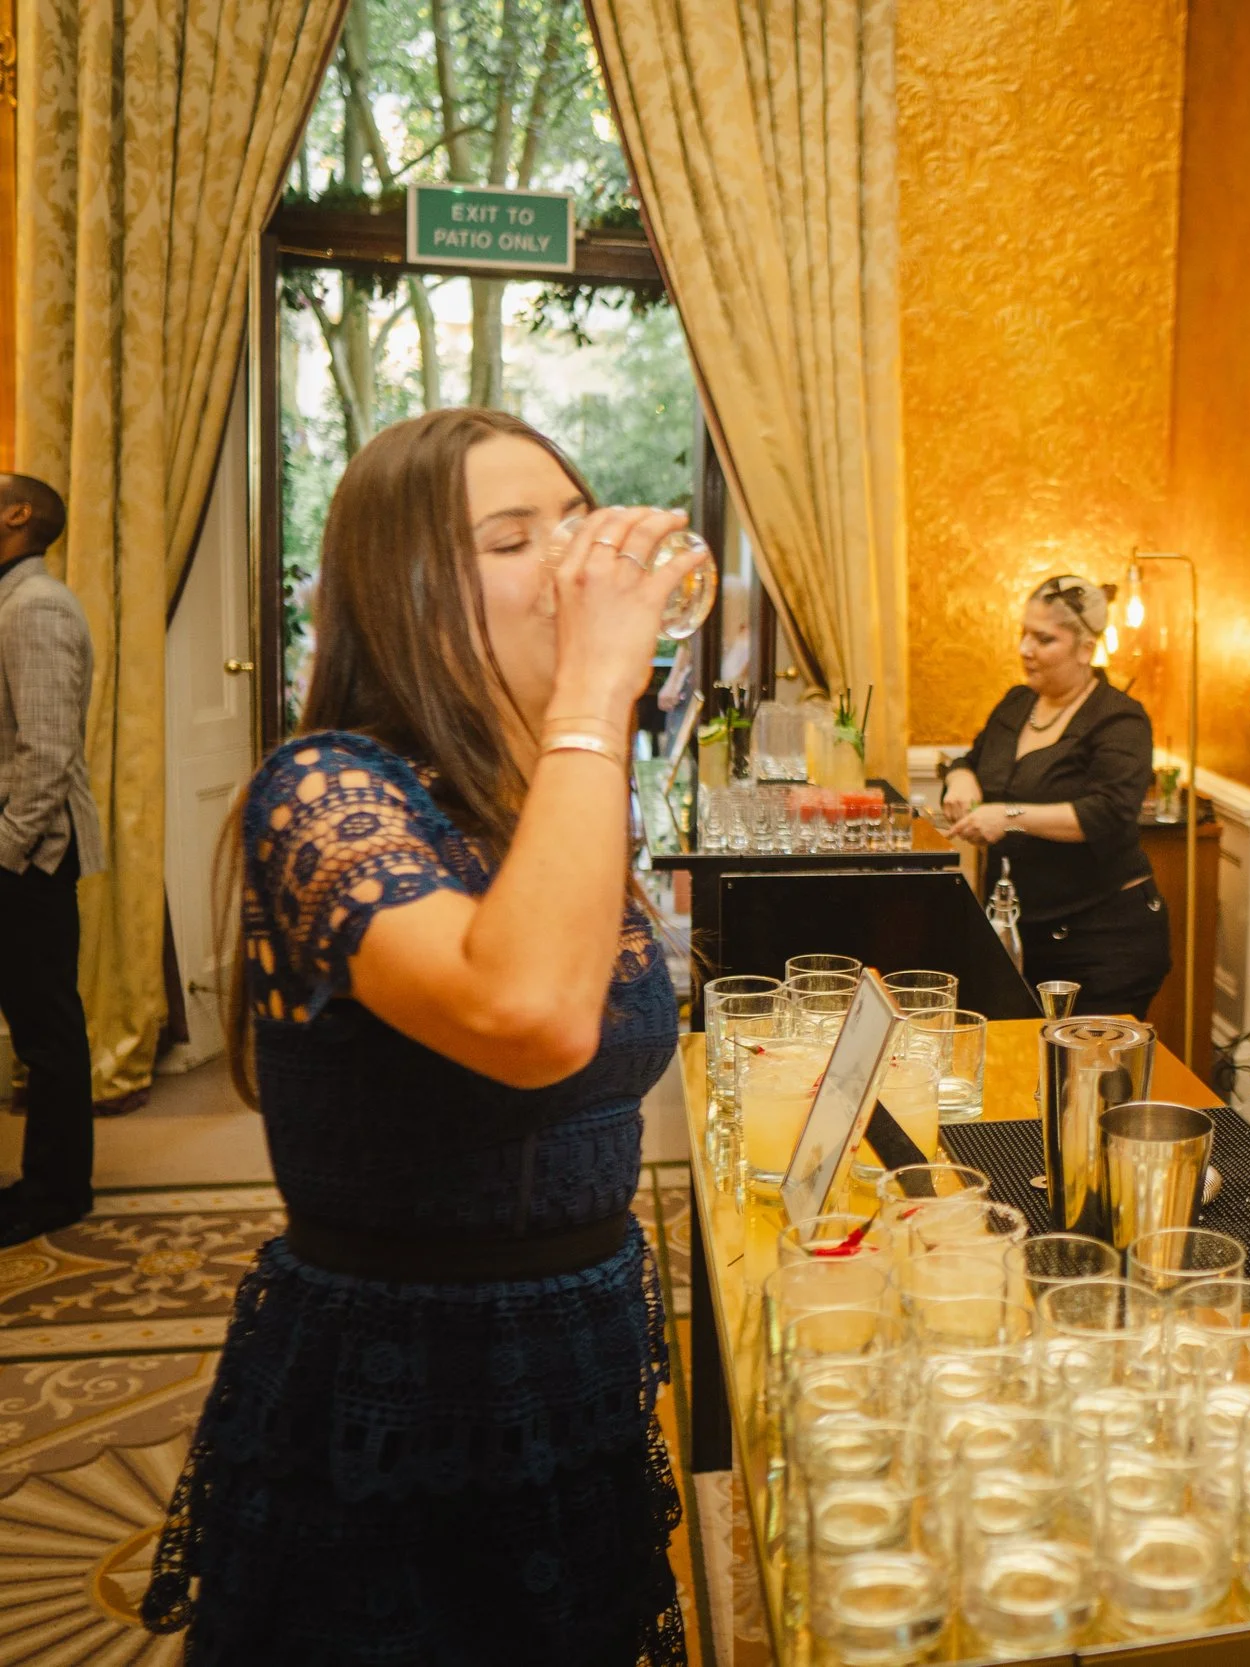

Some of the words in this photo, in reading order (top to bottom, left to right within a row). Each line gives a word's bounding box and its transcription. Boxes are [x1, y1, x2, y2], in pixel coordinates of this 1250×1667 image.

[452, 203, 498, 223] EXIT
[507, 207, 535, 226] TO
[433, 228, 493, 249] PATIO
[499, 232, 551, 252] ONLY
